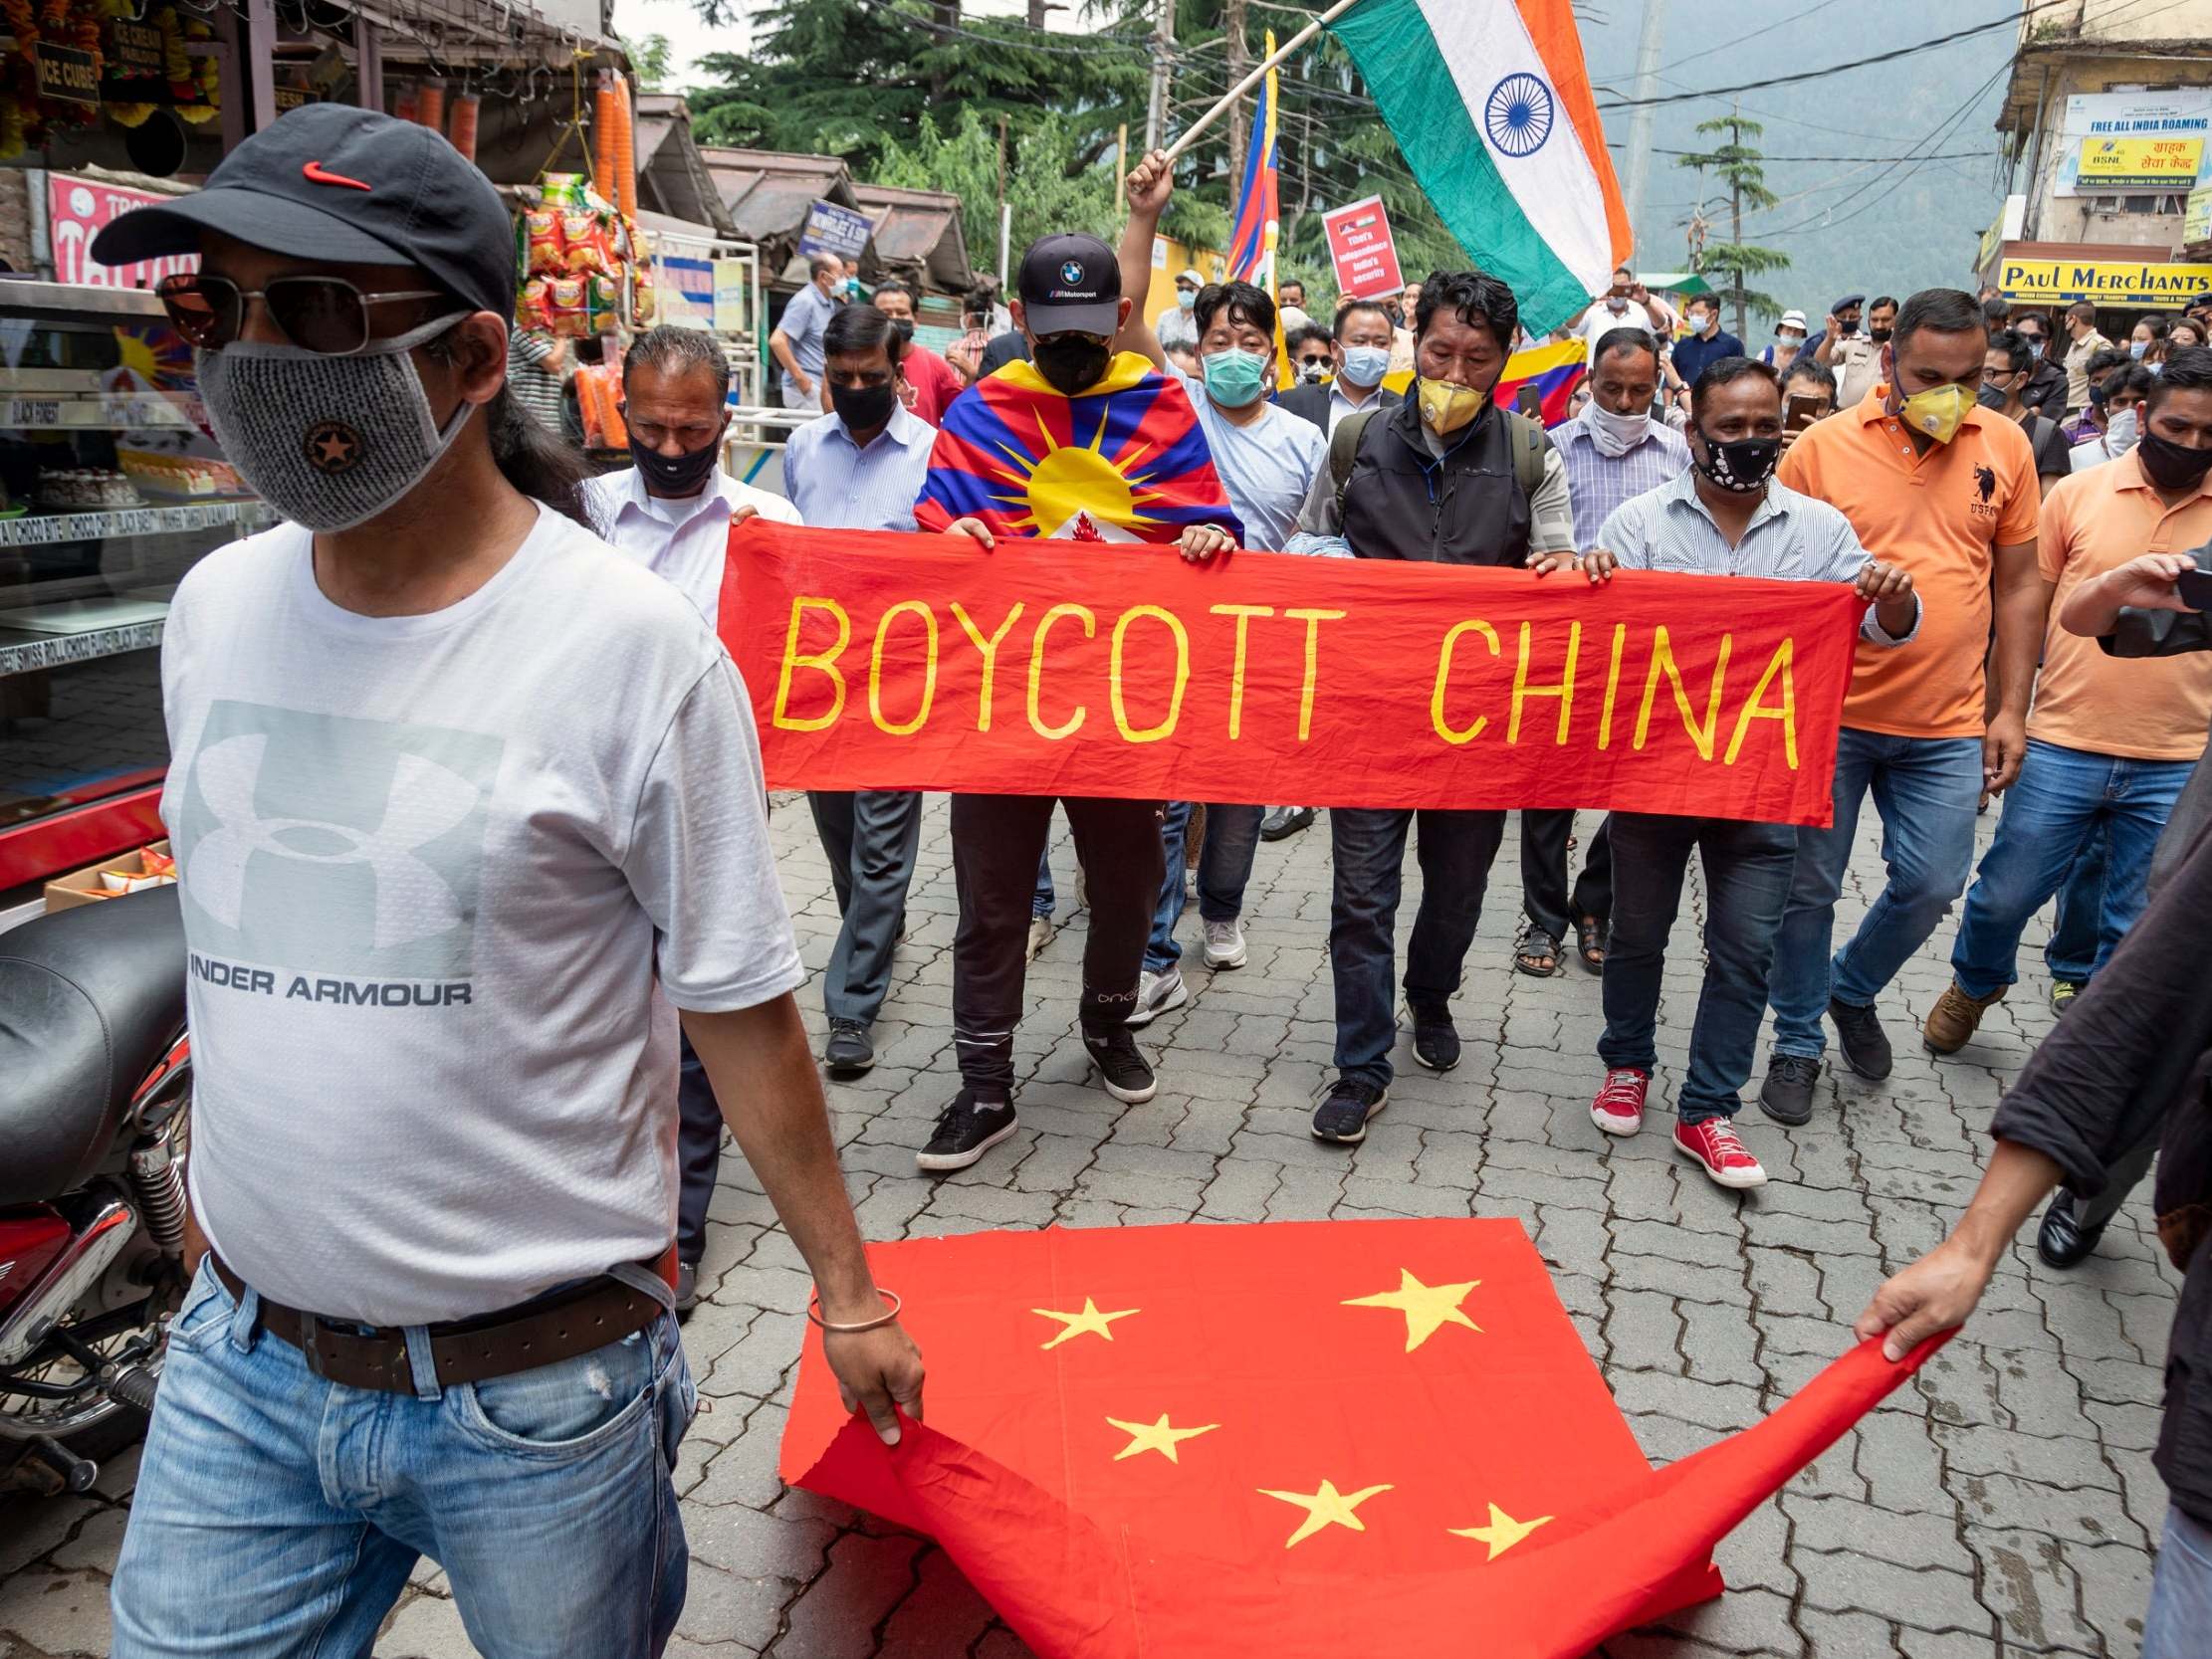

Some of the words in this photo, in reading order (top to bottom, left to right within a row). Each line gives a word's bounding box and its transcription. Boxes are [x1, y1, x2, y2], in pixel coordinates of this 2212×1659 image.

[40, 57, 62, 86] ICE
[62, 62, 96, 90] CUBE
[2092, 120, 2111, 132] FREE
[2113, 120, 2131, 131] ALL
[2133, 120, 2160, 131] INDIA
[2161, 118, 2208, 129] ROAMING
[2093, 155, 2120, 164] BSNL
[15, 518, 44, 543] CHOCO
[69, 516, 95, 539] CHOCO
[773, 596, 1347, 743] BOYCOTT
[1431, 619, 1799, 770] CHINA
[286, 976, 473, 1007] ARMOUR
